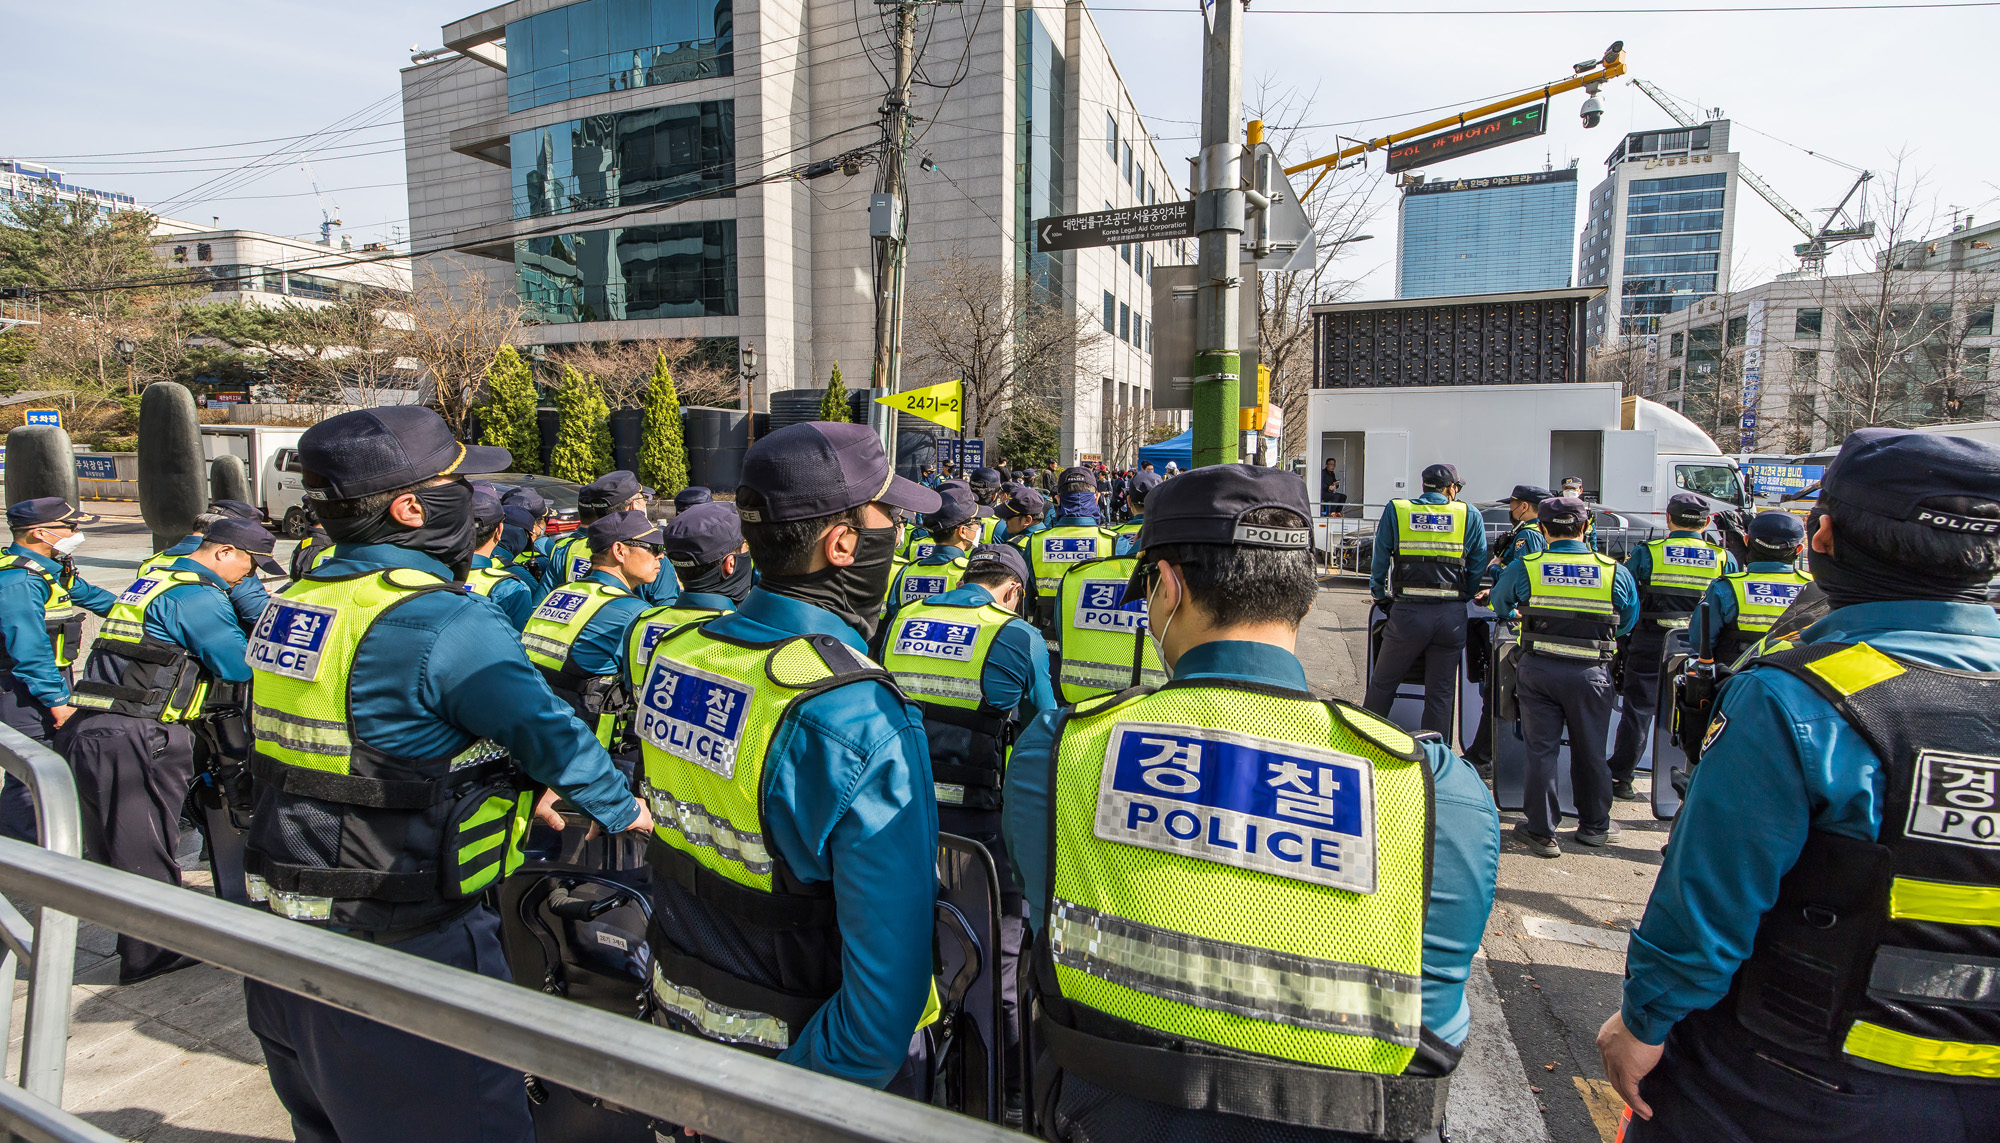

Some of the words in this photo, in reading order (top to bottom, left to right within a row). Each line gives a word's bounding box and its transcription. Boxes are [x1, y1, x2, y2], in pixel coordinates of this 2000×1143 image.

[1062, 211, 1131, 231] 대한법률구조공단
[1132, 205, 1187, 223] 서울중앙지부
[1102, 228, 1119, 236] Korea
[1121, 226, 1137, 235] Legal
[1149, 221, 1187, 231] Corporation
[906, 396, 959, 412] 24기-2
[29, 415, 58, 423] 주차장
[76, 460, 112, 470] 주차장입구
[1415, 514, 1450, 526] 경찰
[1918, 512, 1999, 533] POLICE
[1246, 528, 1306, 543] POLICE
[1050, 540, 1091, 551] 경찰
[1670, 557, 1711, 566] POLICE
[1548, 565, 1595, 580] 경찰
[907, 579, 942, 593] 경찰
[1547, 577, 1595, 586] POLICE
[121, 593, 141, 603] LICE
[548, 591, 584, 611] 경찰
[1754, 596, 1794, 605] POLIC
[538, 607, 572, 620] POLICE
[1085, 612, 1148, 629] POLIC
[907, 621, 970, 645] 경찰
[902, 641, 964, 656] POLICE
[251, 642, 308, 671] POLICE
[652, 669, 736, 733] 경찰
[643, 713, 725, 764] POLICE
[1138, 737, 1341, 825] 경찰
[1942, 766, 1996, 808] 경
[1127, 801, 1340, 872] POLICE
